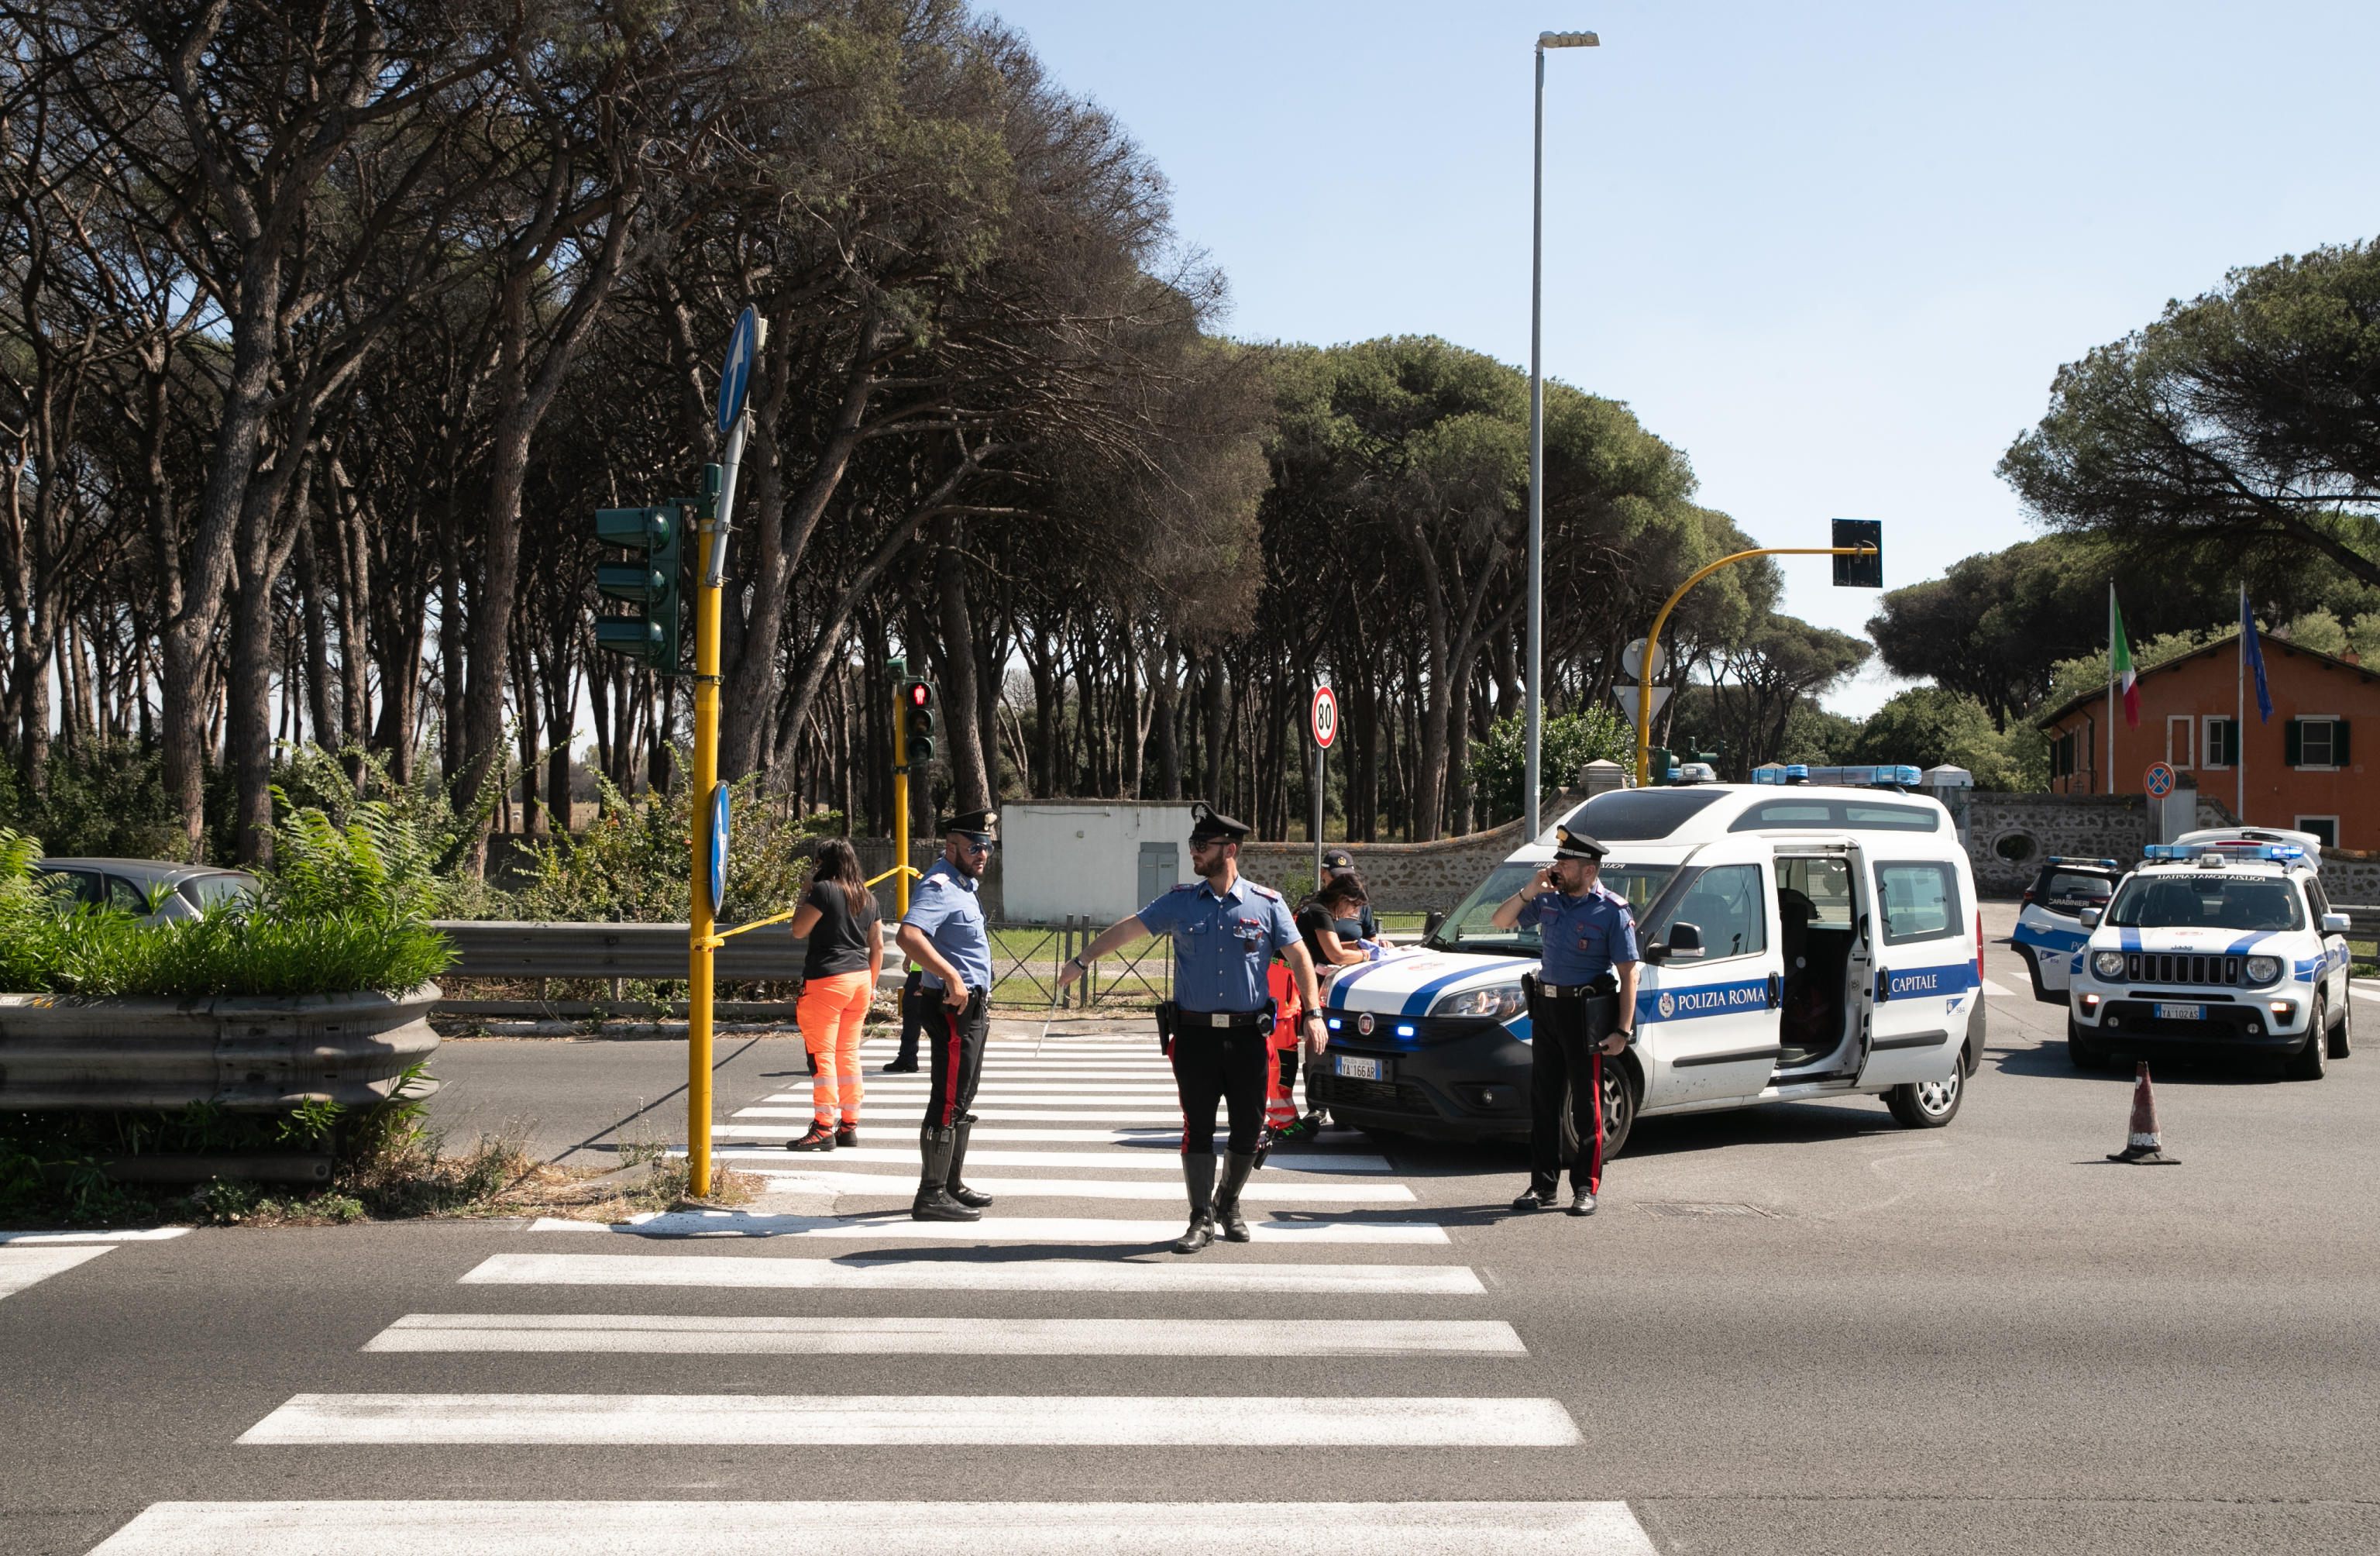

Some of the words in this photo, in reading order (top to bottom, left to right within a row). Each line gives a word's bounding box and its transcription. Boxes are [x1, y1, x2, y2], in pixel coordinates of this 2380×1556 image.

[1319, 703, 1331, 730] 80
[1892, 974, 1938, 993] CAPITALE
[1679, 991, 1726, 1010] POLIZIA
[1729, 986, 1766, 1005] ROMA
